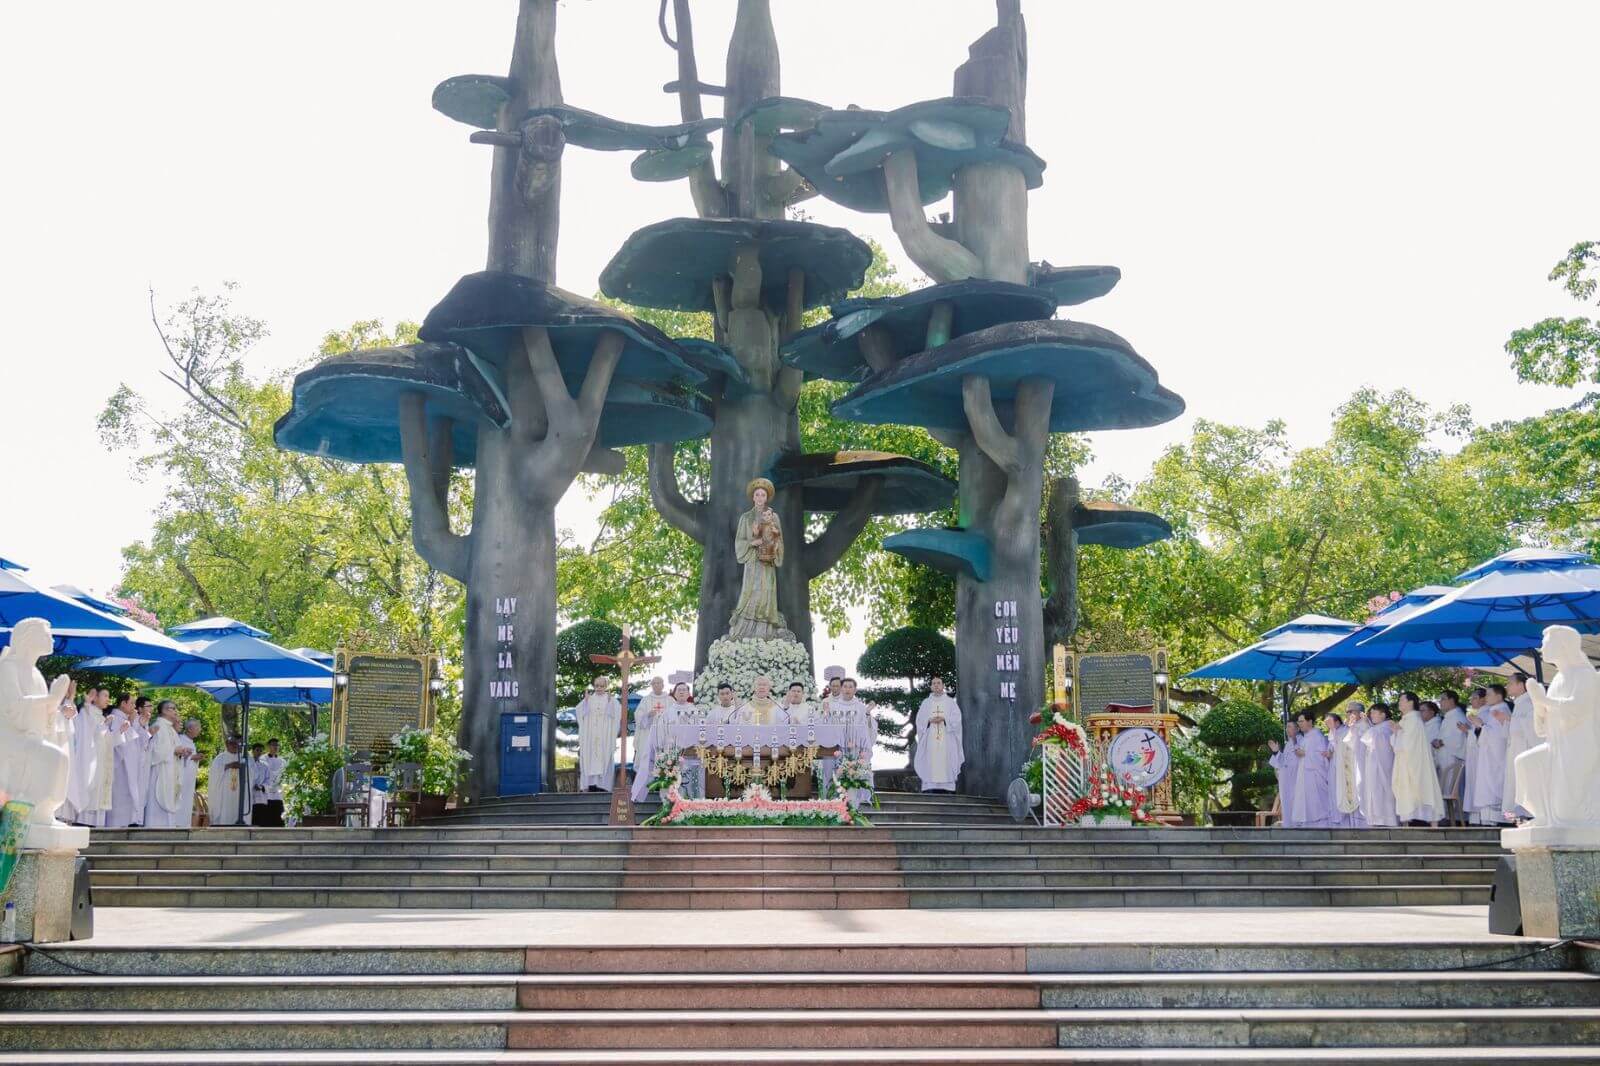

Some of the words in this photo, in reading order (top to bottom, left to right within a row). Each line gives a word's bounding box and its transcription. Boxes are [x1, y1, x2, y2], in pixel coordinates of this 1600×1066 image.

[995, 601, 1017, 617] CON
[996, 624, 1018, 643] YÊU
[490, 681, 519, 697] VANG
[1000, 682, 1016, 702] MẸ
